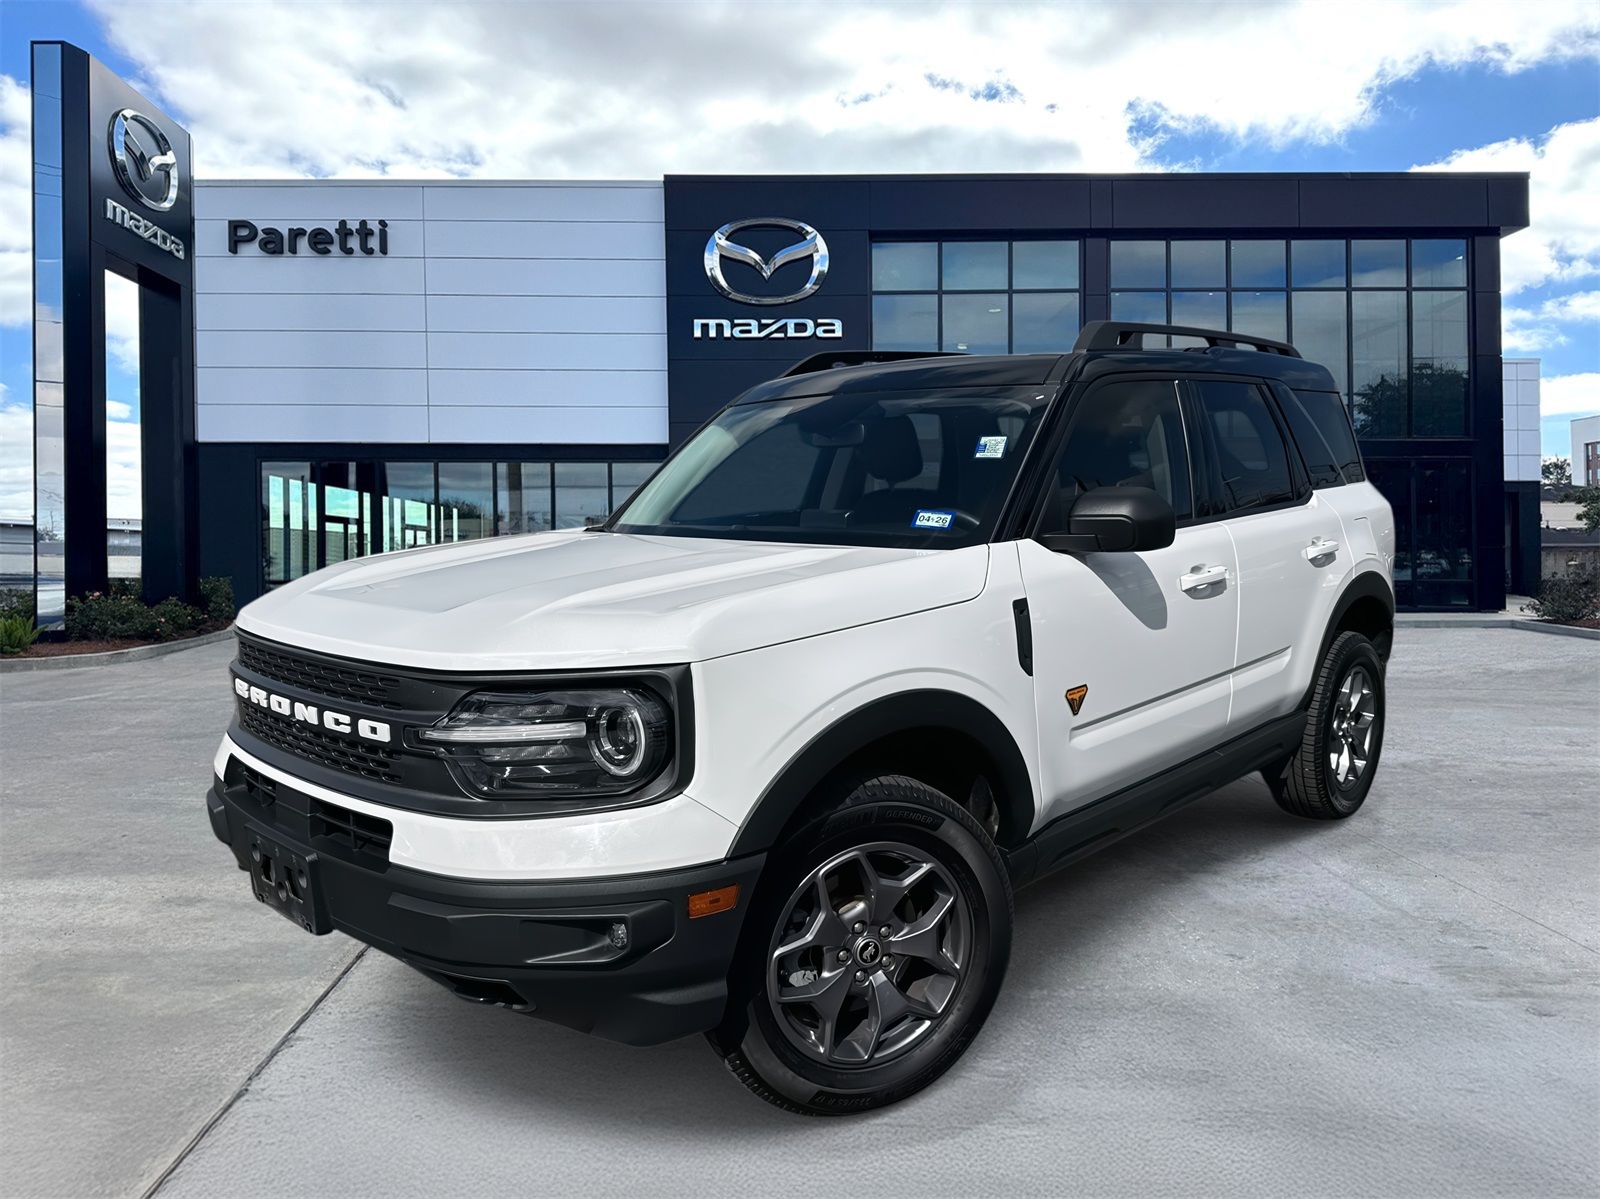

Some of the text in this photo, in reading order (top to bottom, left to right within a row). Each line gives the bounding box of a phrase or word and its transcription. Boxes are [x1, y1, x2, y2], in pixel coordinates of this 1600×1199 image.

[227, 219, 389, 256] Paretti
[934, 516, 949, 525] 26
[234, 677, 391, 743] BRONCO
